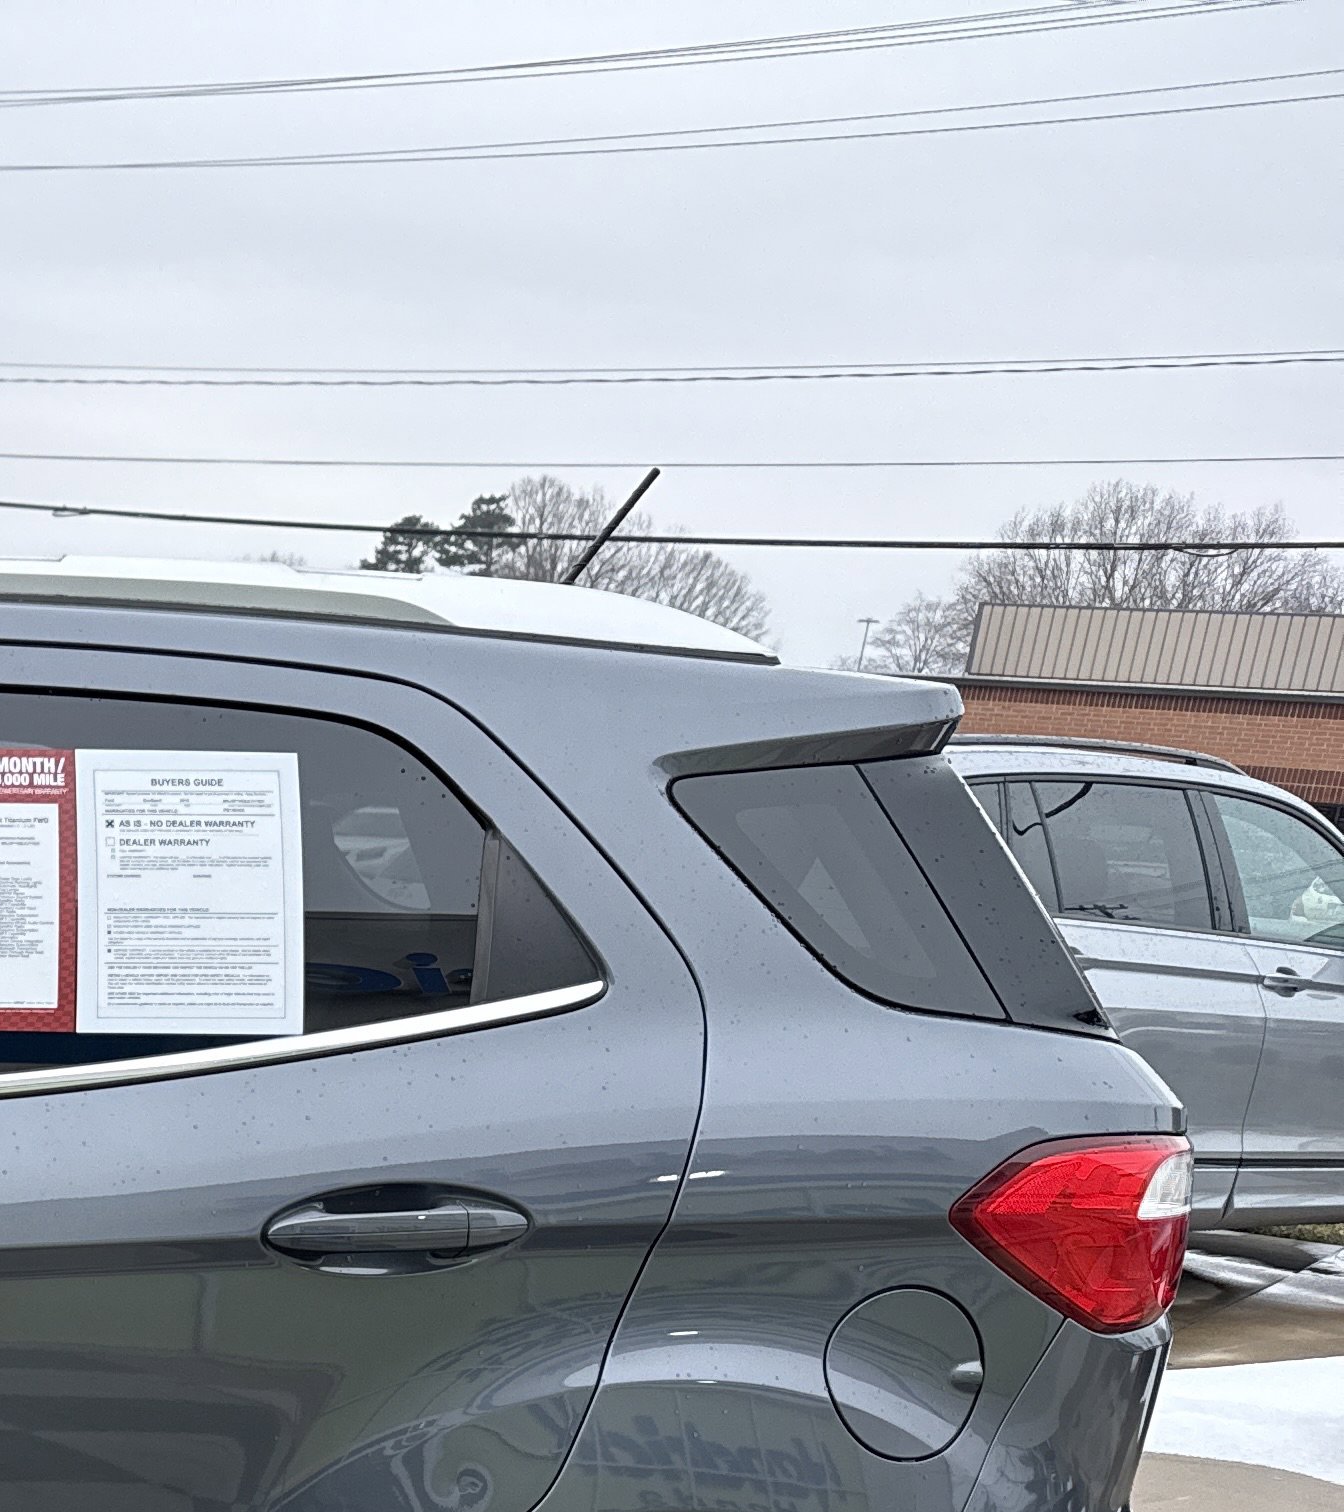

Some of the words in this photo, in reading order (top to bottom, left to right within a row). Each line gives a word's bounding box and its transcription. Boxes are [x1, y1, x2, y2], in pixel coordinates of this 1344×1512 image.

[33, 773, 66, 786] MILE
[150, 778, 191, 787] BUYERS
[193, 778, 225, 787] GUIDE
[118, 819, 131, 828] AS
[133, 819, 143, 828] IS
[149, 819, 164, 828] NO
[165, 819, 203, 828] DEALER
[204, 819, 257, 829] WARRANTY
[118, 838, 156, 847] DEALER
[157, 838, 212, 847] WARRANTY
